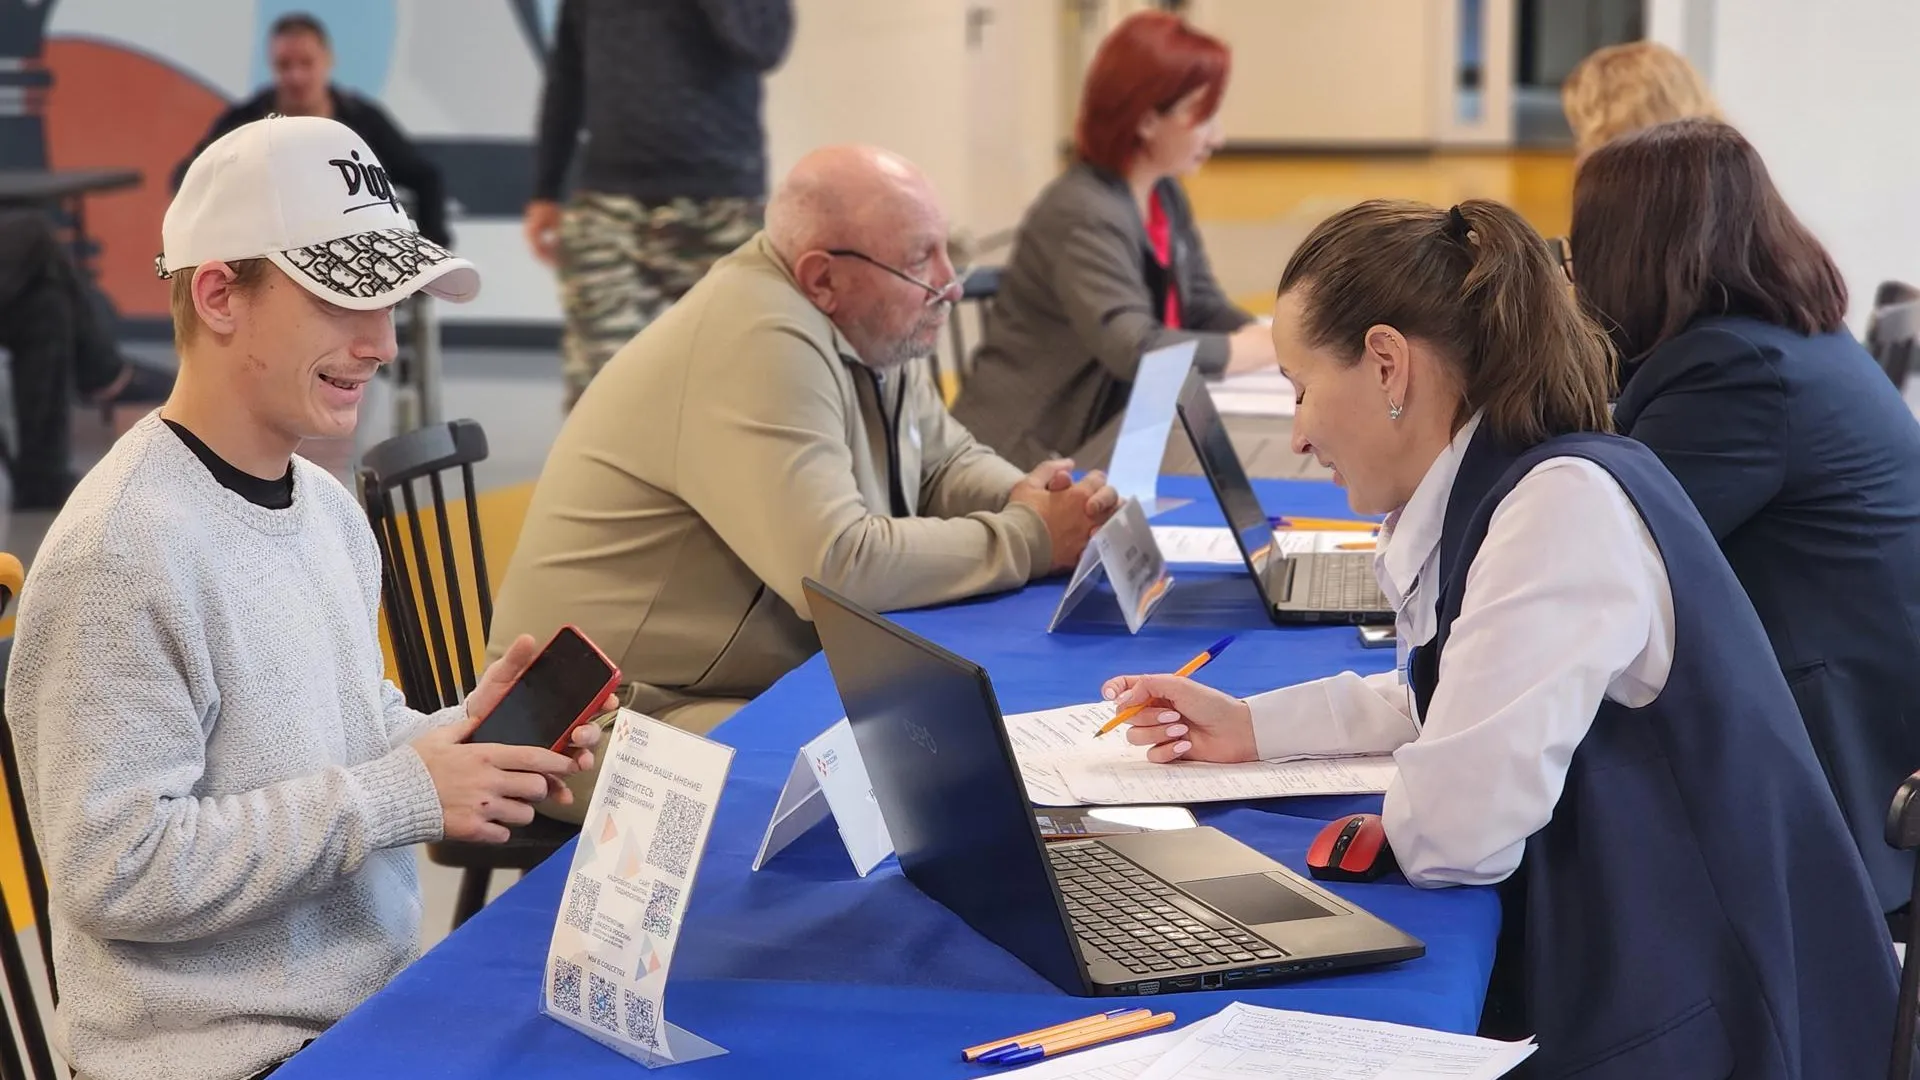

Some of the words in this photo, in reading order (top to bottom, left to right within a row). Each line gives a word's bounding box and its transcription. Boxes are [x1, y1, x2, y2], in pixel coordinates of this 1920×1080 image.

[629, 735, 649, 747] РОССИИ
[631, 726, 649, 739] РАБОТА
[615, 751, 630, 763] НАМ
[630, 757, 653, 773] ВАЖНО
[653, 767, 673, 781] ВАШЕ
[673, 773, 703, 792] МНЕНИЕ!
[611, 773, 654, 798] ПОДЕЛИТЕСЬ
[607, 785, 655, 811] ВПЕЧАТЛЕНИЯМИ
[610, 798, 621, 809] НАС
[587, 953, 597, 963] МЫ
[600, 960, 626, 977] СОЦСЕТЯХ
